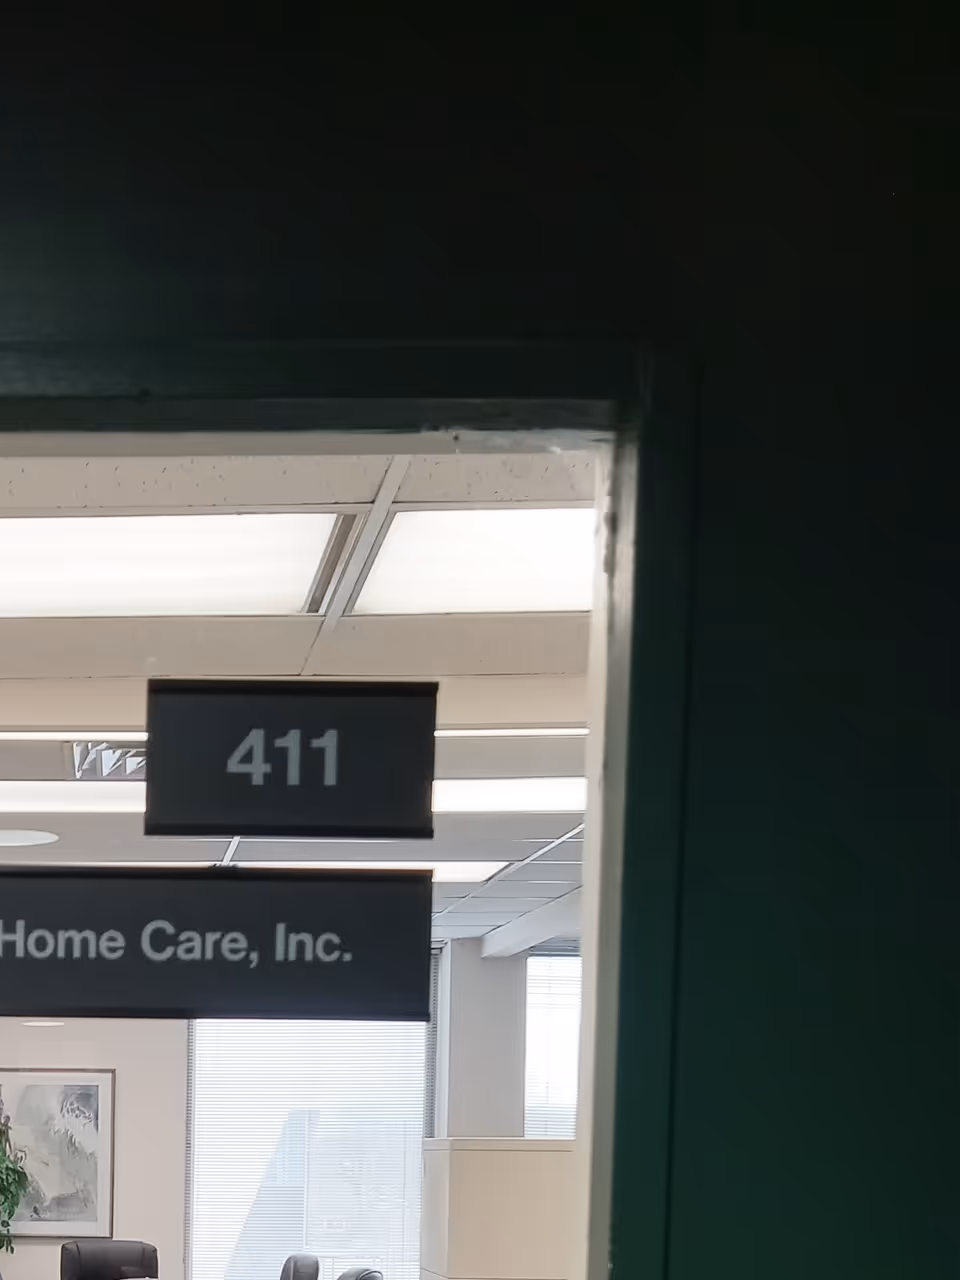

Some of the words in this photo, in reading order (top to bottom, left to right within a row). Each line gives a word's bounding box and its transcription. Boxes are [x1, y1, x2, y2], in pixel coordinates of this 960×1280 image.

[227, 729, 338, 786] 411
[140, 919, 259, 968] Care,
[275, 923, 353, 962] Inc.
